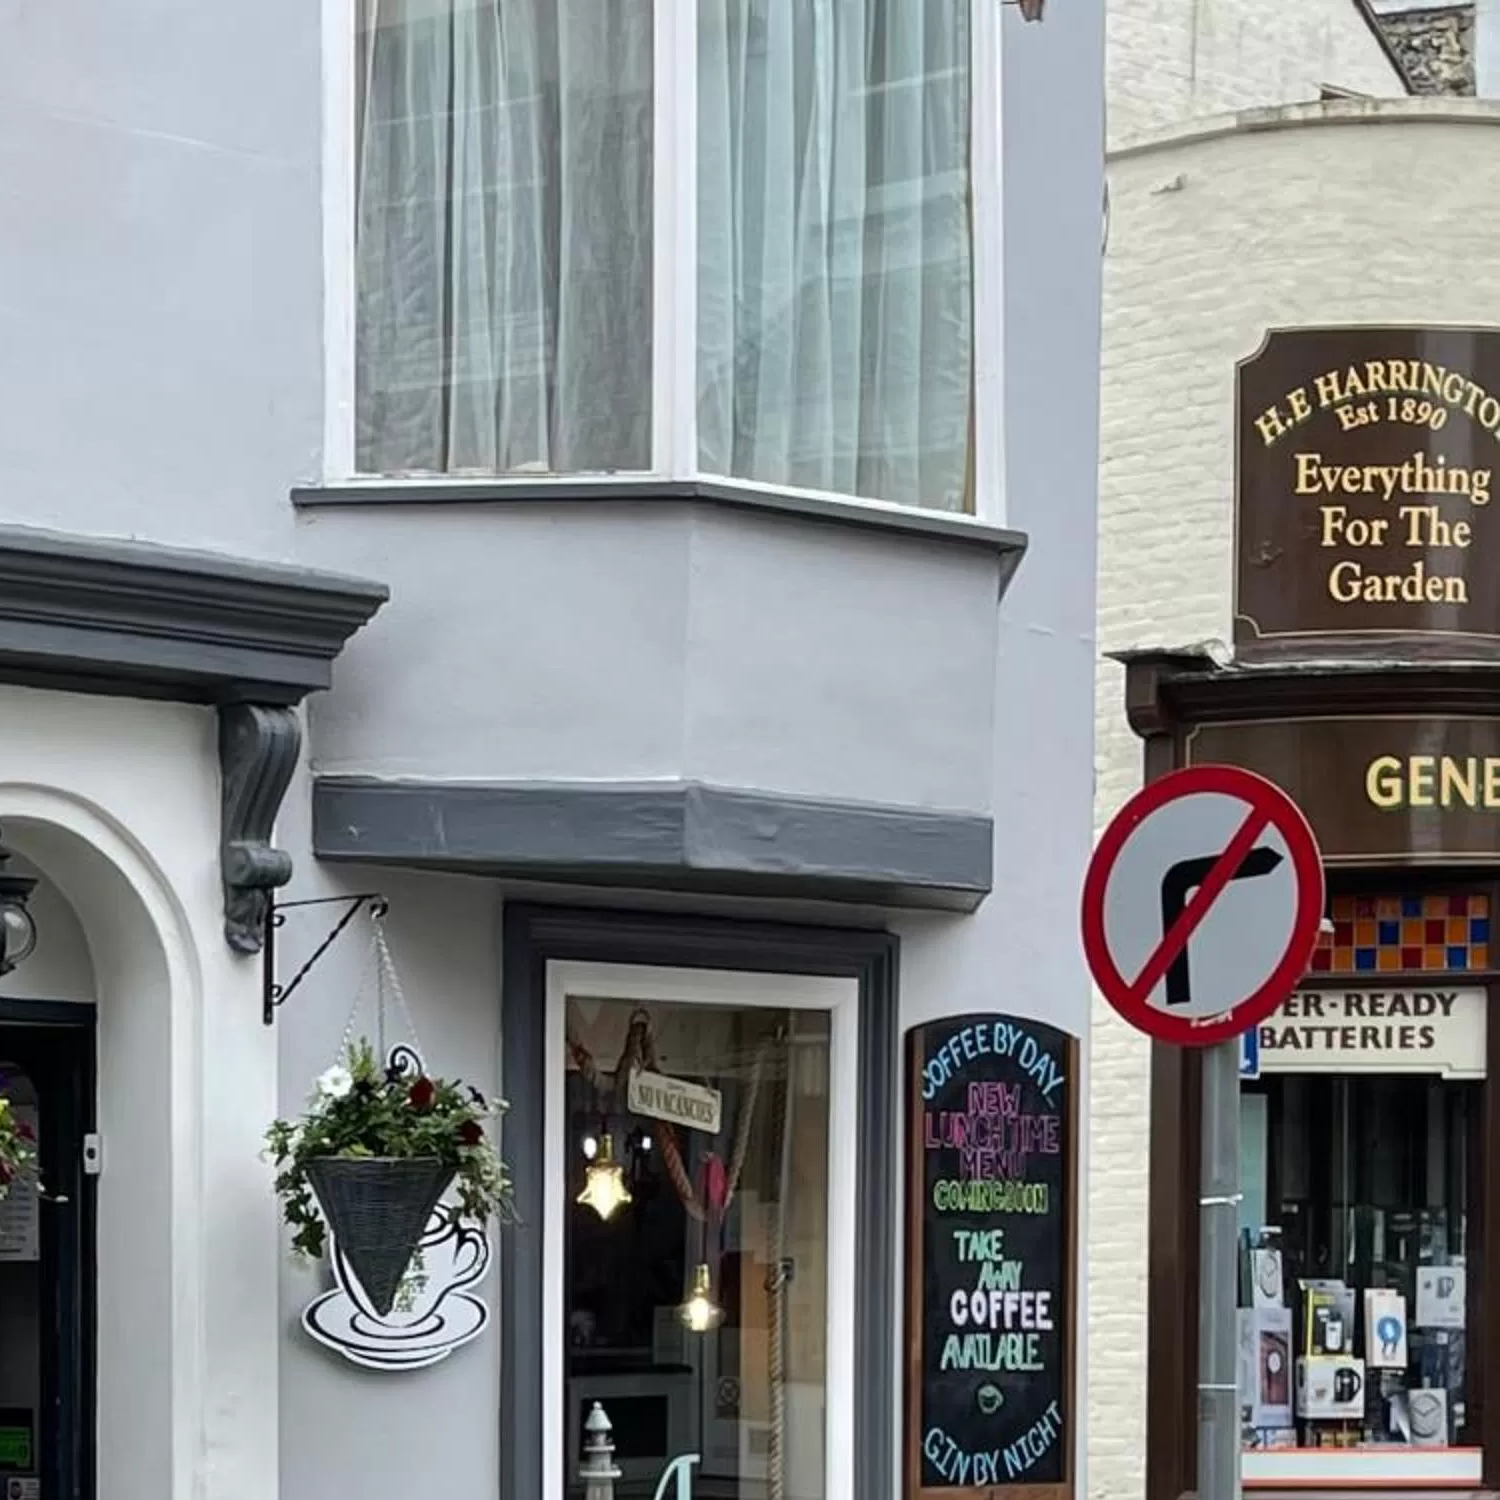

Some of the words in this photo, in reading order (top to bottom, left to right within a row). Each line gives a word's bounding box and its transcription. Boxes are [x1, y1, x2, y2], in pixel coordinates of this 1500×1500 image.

[1314, 359, 1500, 441] HARRINGTO
[1334, 401, 1380, 431] Est
[1387, 397, 1447, 431] 1890
[1293, 451, 1491, 505] Everything
[1319, 505, 1388, 546] For
[1399, 505, 1471, 547] The
[1329, 561, 1468, 603] Garden
[1366, 756, 1500, 807] GENE
[1273, 992, 1458, 1017] ER-READY
[1259, 1026, 1435, 1050] BATTERIES
[922, 1024, 991, 1099] COFFEE
[993, 1022, 1024, 1057] BY
[967, 1081, 1021, 1116] NEW
[960, 1148, 1026, 1182] MENU
[953, 1229, 1003, 1261] TAKE
[978, 1260, 1023, 1290] AWAY
[950, 1288, 1053, 1330] COFFEE
[940, 1332, 1044, 1371] AVAILABLE
[924, 1427, 970, 1487] GIN
[973, 1450, 1000, 1487] BY
[1003, 1400, 1063, 1479] NIGHT
